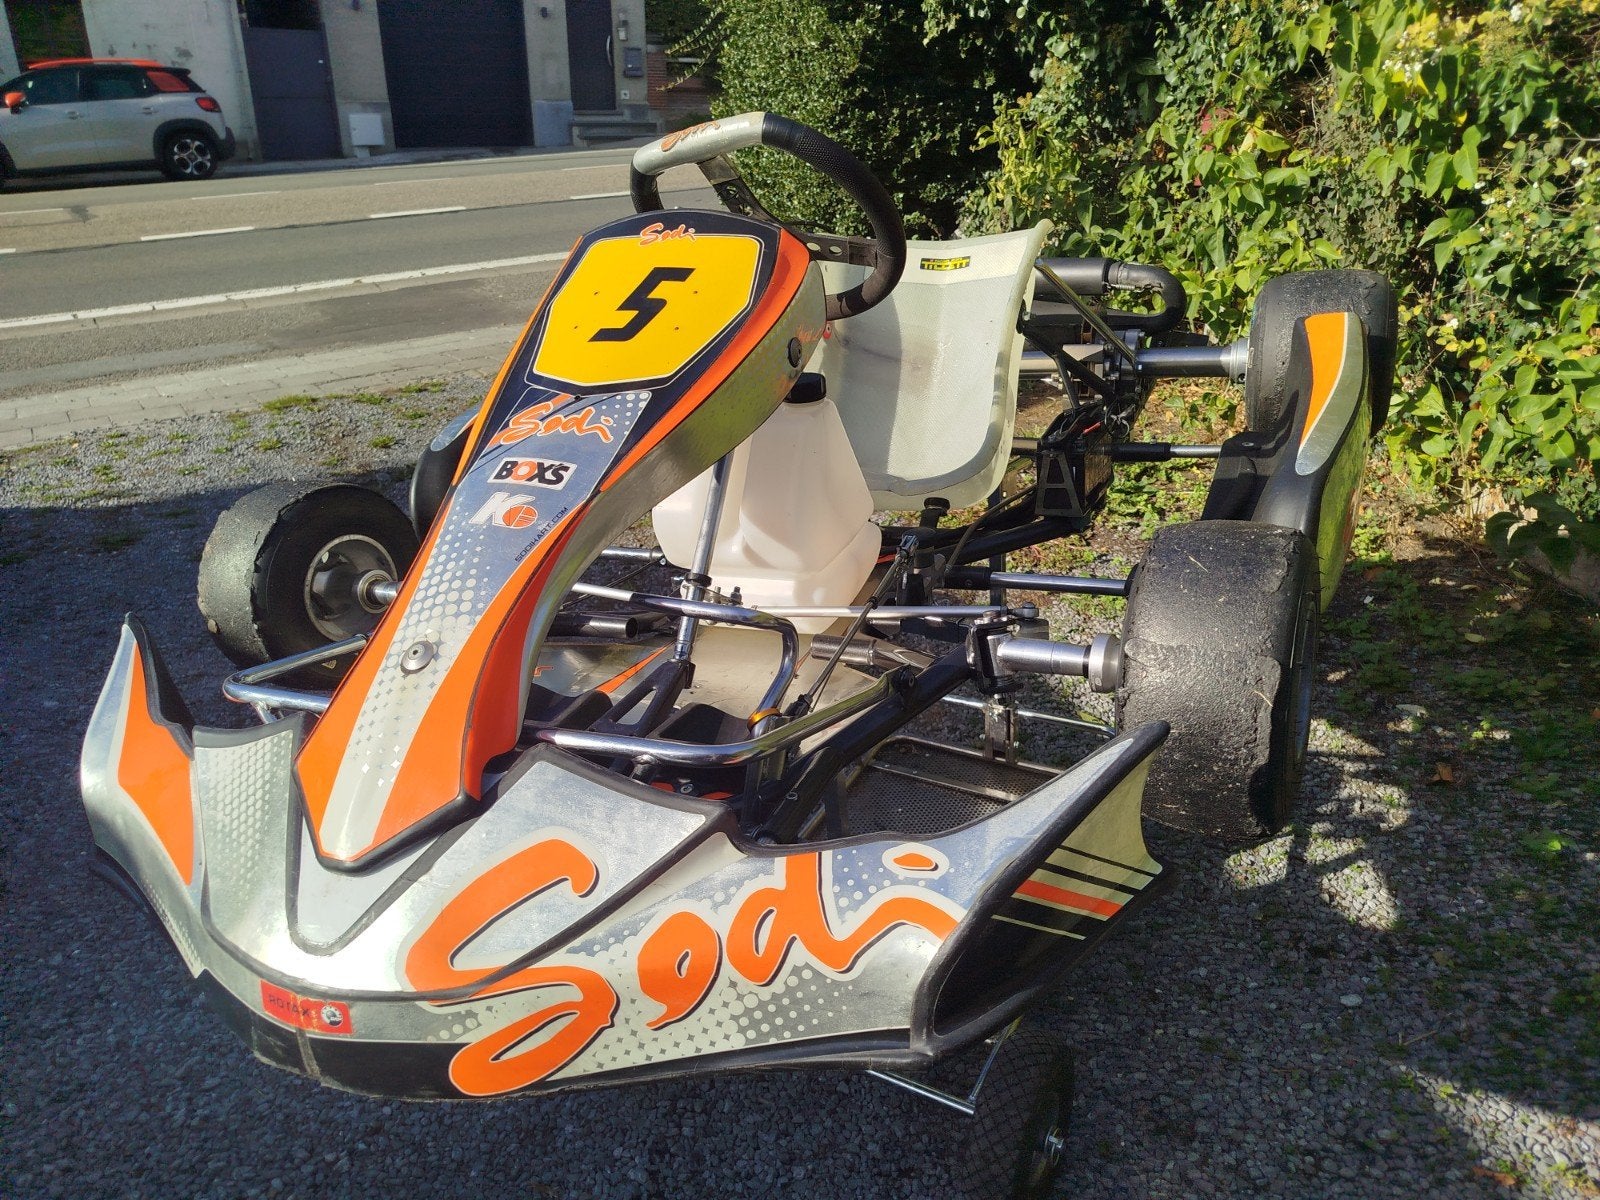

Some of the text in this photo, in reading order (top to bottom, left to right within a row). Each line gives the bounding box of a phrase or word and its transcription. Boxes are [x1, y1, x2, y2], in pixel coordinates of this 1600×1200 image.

[639, 222, 698, 247] Sodi
[587, 266, 696, 342] 5
[500, 401, 614, 446] Sodi
[404, 837, 961, 1096] Sodi
[267, 994, 310, 1017] ROTAX
